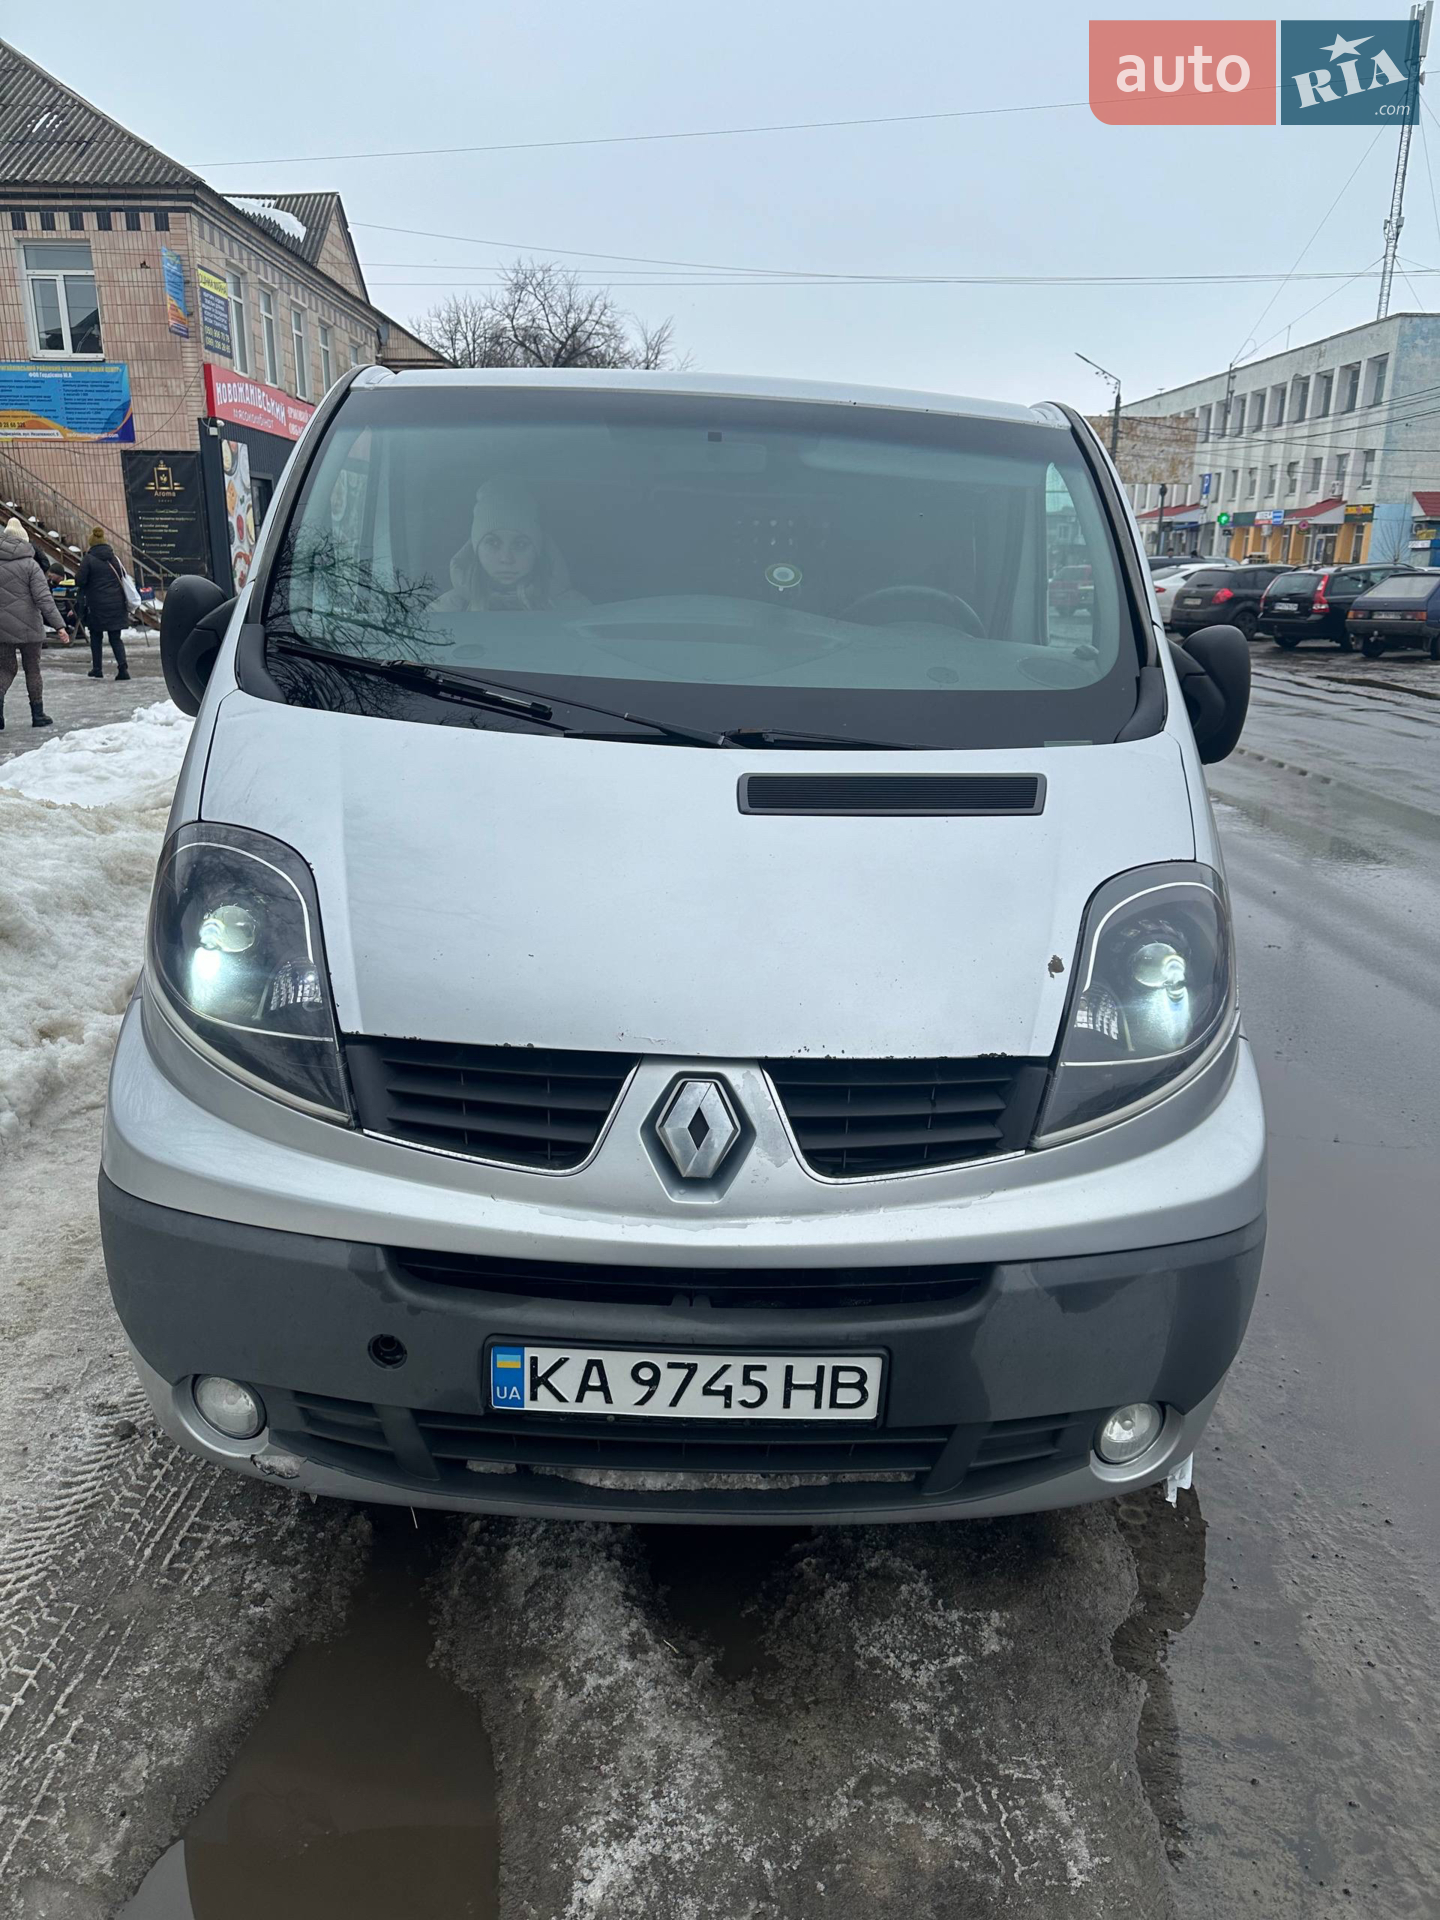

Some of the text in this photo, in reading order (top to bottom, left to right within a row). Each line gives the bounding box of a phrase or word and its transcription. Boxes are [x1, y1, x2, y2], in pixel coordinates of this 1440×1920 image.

[496, 1386, 521, 1401] UA
[529, 1355, 869, 1410] KA 9745 HB
